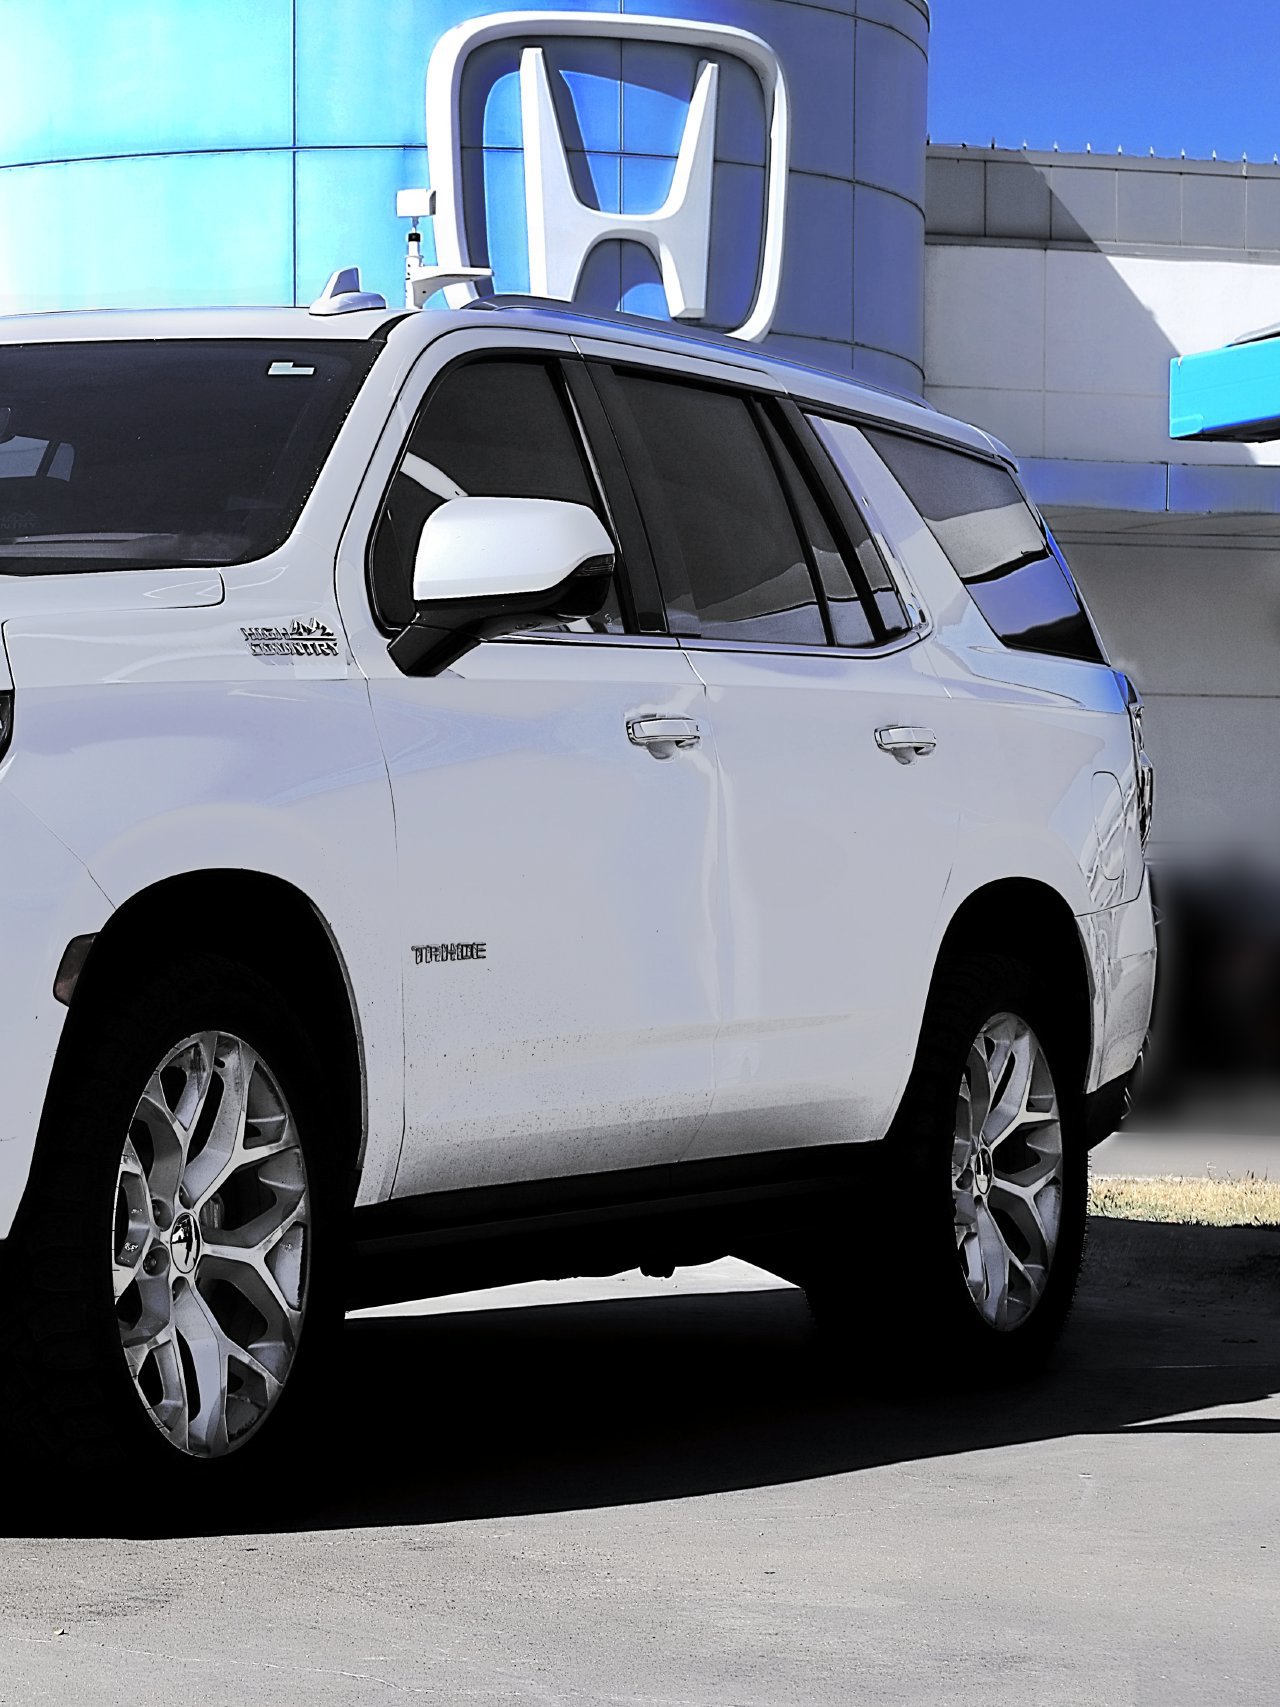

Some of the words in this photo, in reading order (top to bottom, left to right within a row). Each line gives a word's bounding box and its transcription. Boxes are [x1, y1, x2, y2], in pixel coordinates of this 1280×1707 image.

[240, 627, 291, 641] HIGH
[248, 642, 339, 656] COUNTRY
[411, 942, 487, 964] TAHOE
